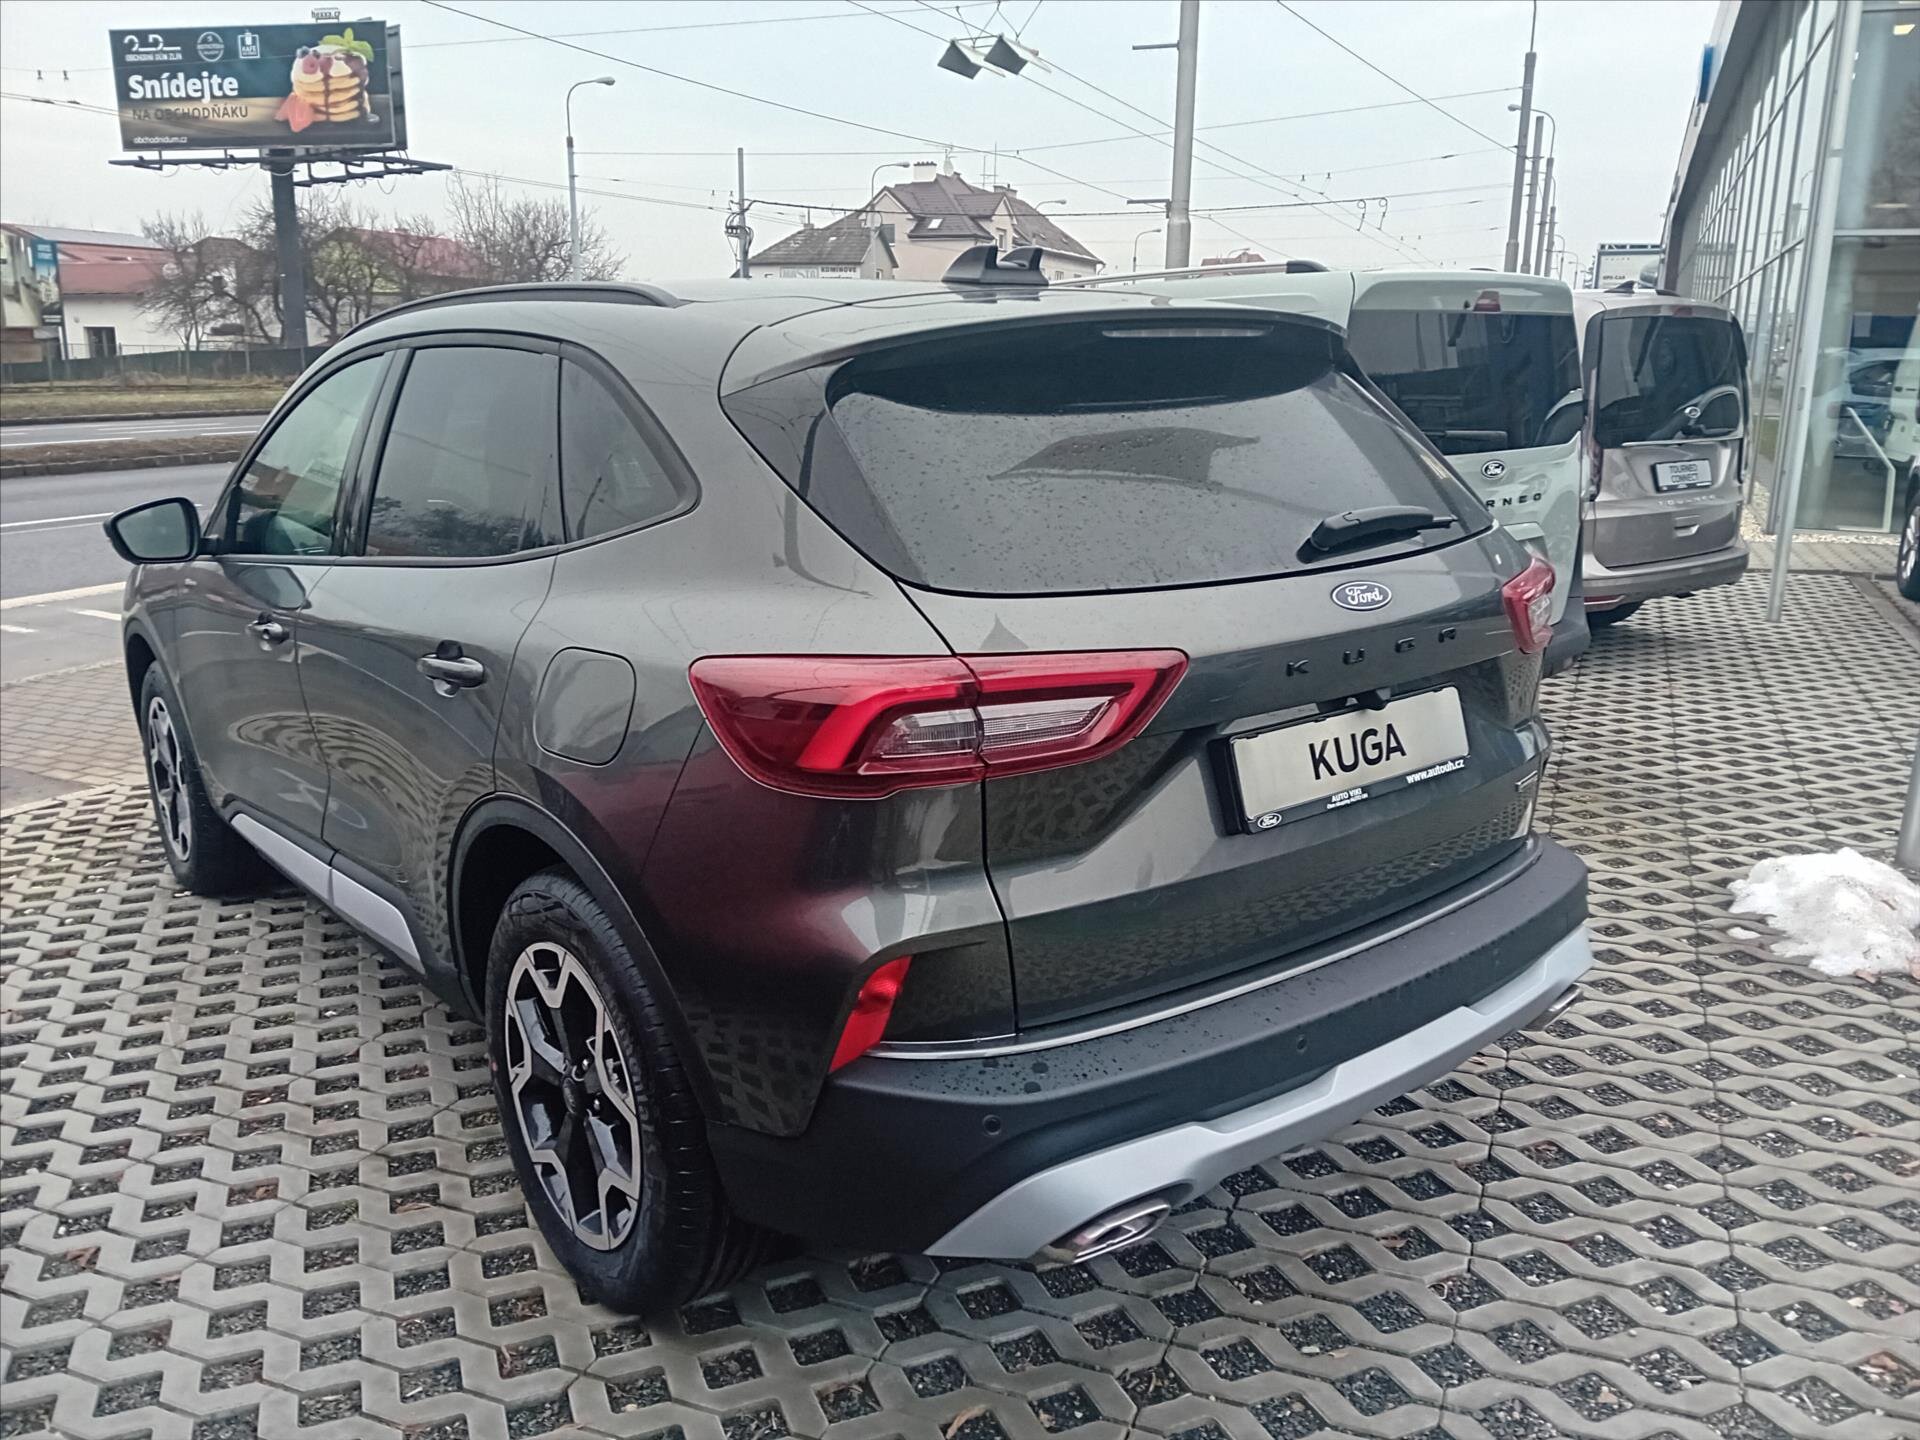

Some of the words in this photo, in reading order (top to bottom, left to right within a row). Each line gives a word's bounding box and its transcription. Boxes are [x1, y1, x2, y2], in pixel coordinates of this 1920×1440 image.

[128, 71, 239, 104] Snídejte
[132, 108, 152, 120] NA
[154, 102, 249, 120] OBCHODŇÁKU
[1486, 492, 1542, 507] RNEO
[1308, 723, 1407, 780] KUGA
[1405, 759, 1465, 784] www.autouh.cz
[1331, 791, 1348, 802] AUTO
